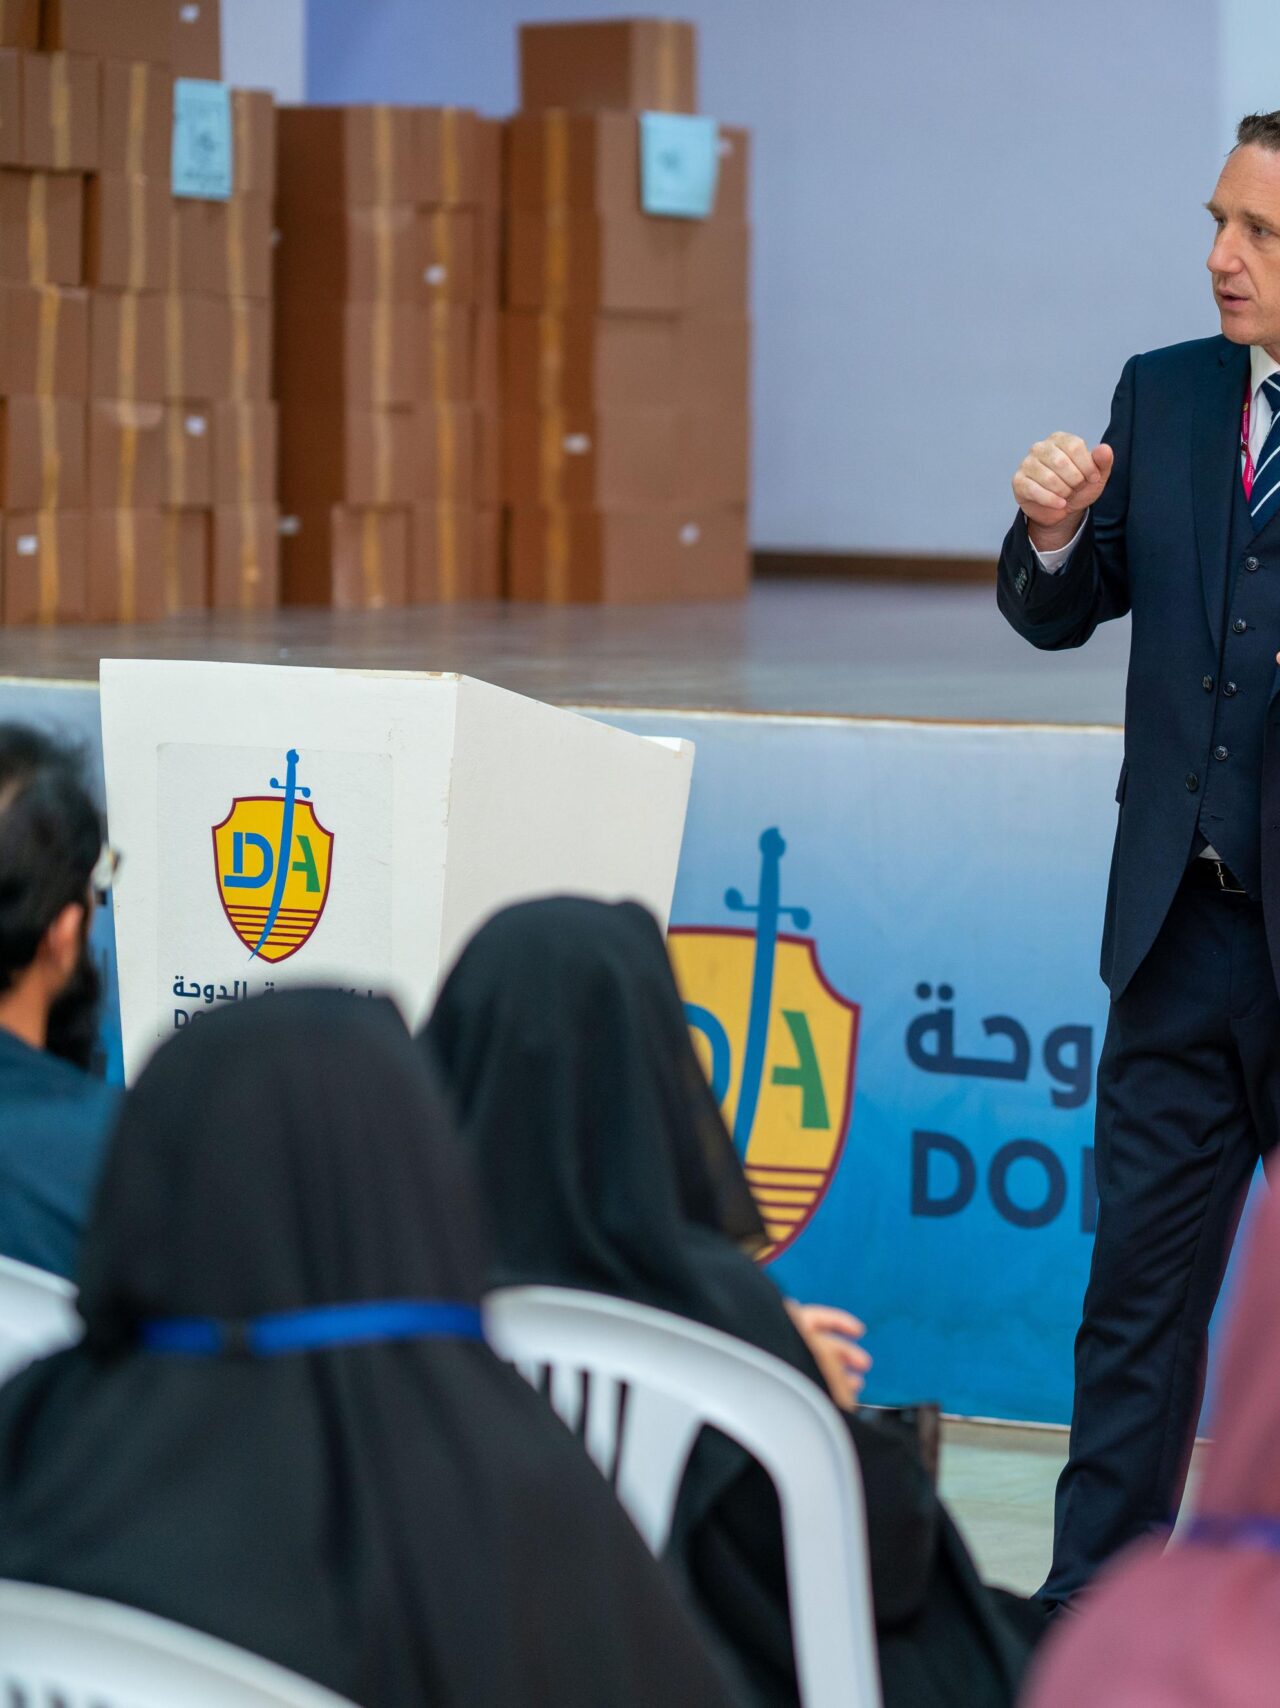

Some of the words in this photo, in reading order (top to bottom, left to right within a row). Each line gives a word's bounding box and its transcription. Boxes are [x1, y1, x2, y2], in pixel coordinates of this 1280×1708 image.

[172, 975, 248, 1004] الدوحة
[905, 982, 1094, 1110] وحة
[910, 1130, 1097, 1235] DO
